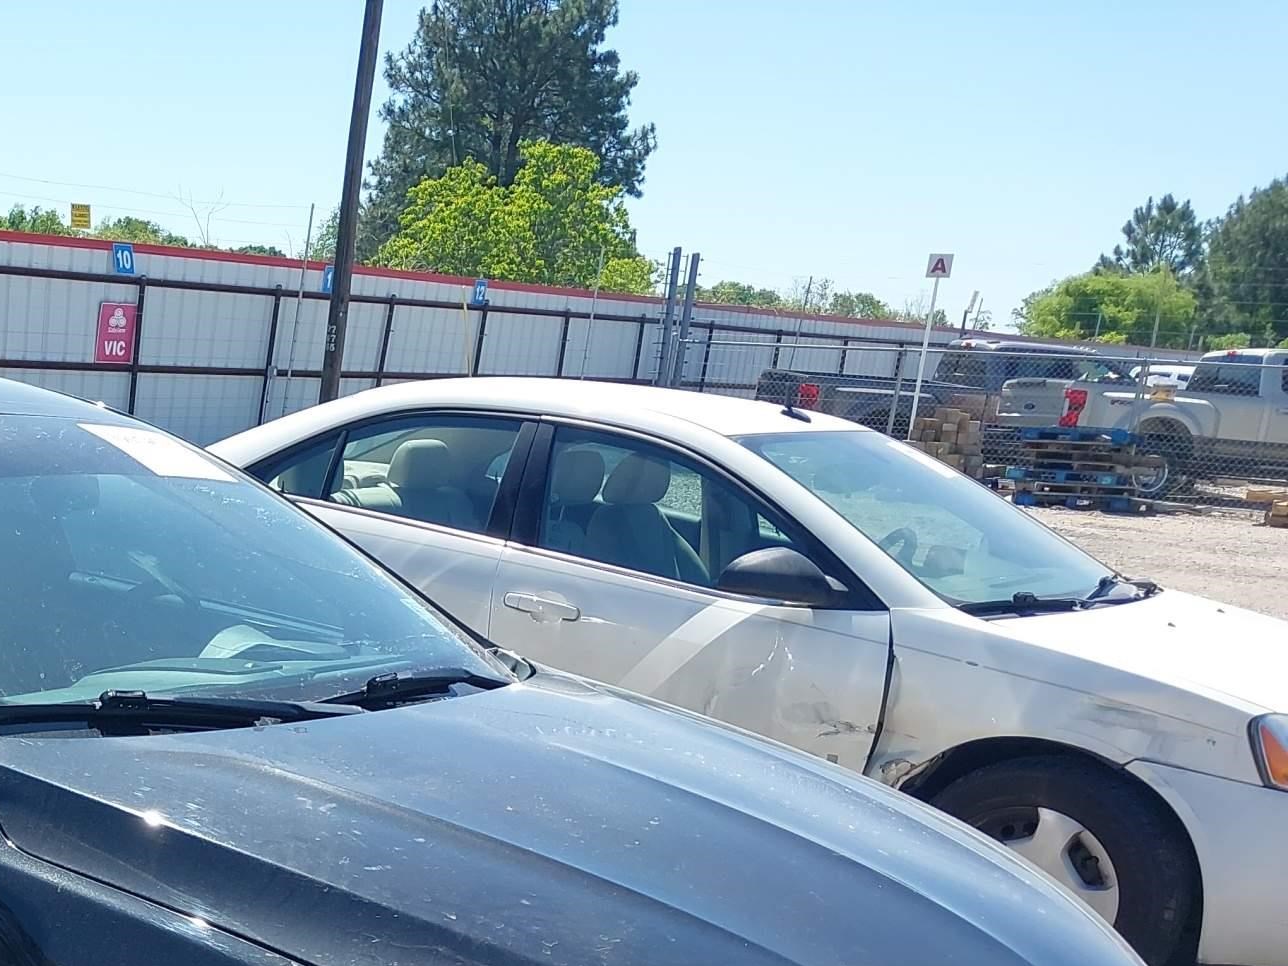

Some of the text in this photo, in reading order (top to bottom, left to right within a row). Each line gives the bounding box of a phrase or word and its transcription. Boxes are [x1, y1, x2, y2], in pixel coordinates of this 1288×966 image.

[116, 249, 132, 270] 10
[930, 257, 947, 274] A
[475, 285, 485, 301] 12
[104, 340, 126, 356] VIC
